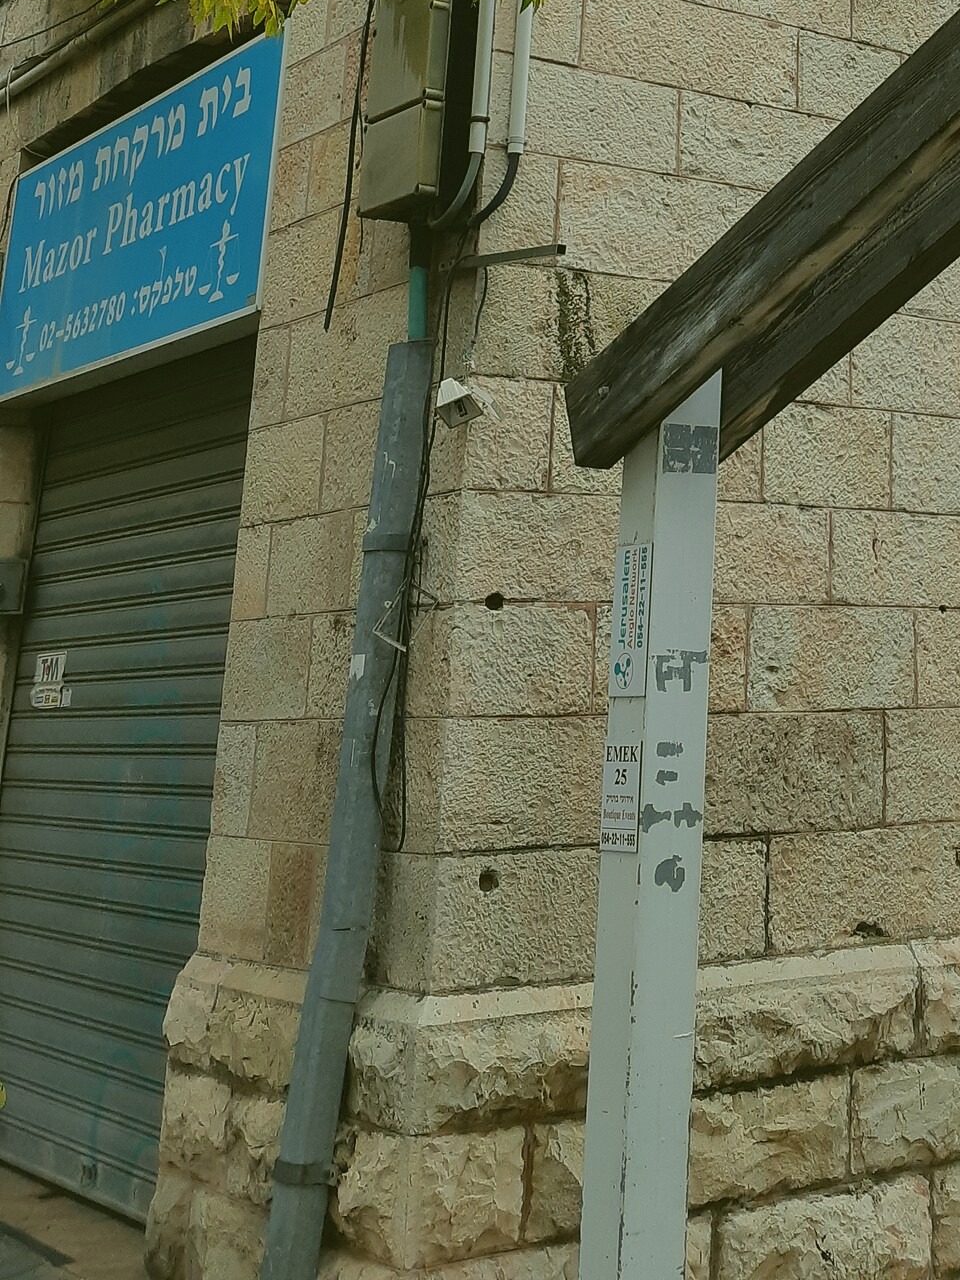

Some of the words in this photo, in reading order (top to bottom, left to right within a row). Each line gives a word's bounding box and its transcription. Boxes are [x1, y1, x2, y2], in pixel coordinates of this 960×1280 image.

[197, 66, 252, 137] בית
[92, 103, 186, 192] מרקחת
[34, 159, 84, 220] מזור
[18, 226, 98, 294] Mazor
[102, 152, 250, 255] Pharmacy
[39, 291, 126, 350] 02-5632780
[131, 265, 198, 318] טלפקס:
[617, 549, 631, 650] Jerusalem
[629, 548, 638, 606] Network
[636, 546, 648, 649] 054-22-11-555
[627, 611, 635, 650] Anglo
[606, 745, 639, 762] EMEK
[614, 768, 627, 785] 25
